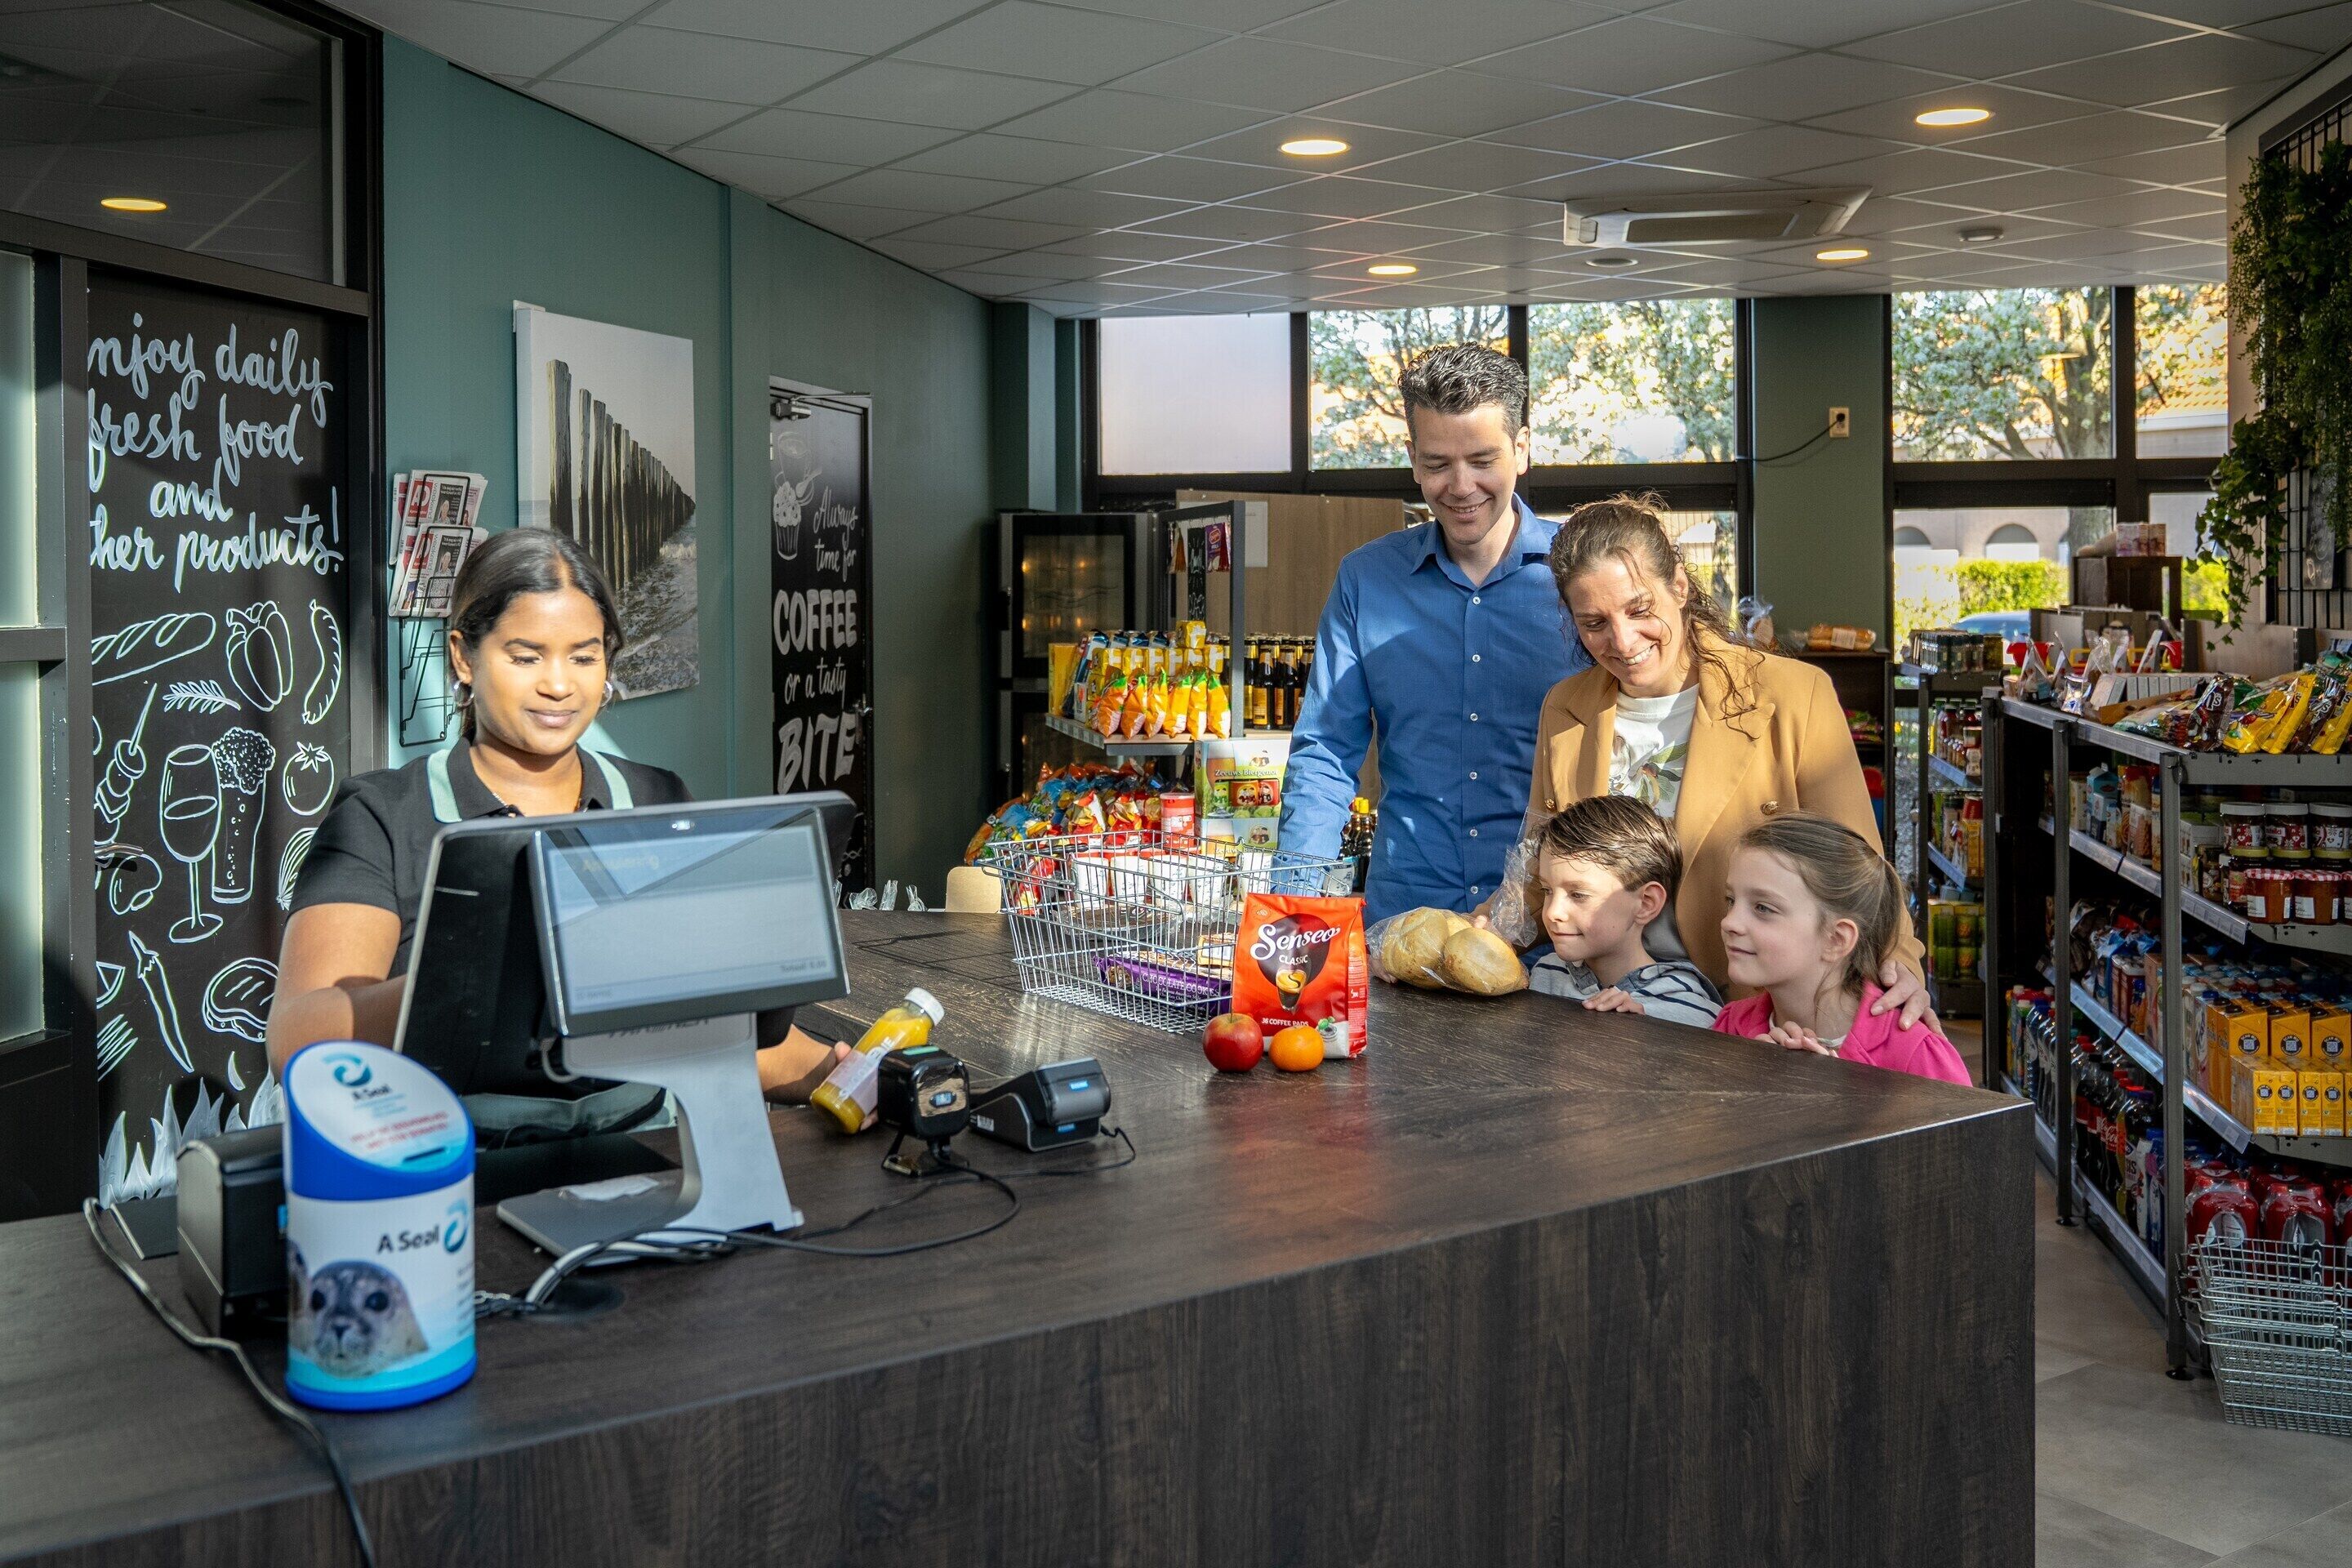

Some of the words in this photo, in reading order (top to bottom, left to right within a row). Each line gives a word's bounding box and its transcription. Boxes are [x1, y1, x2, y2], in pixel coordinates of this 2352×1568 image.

[87, 312, 205, 410] njoy
[216, 323, 333, 428] daily
[88, 388, 201, 492] fresh
[220, 393, 303, 486] food
[150, 457, 233, 521] and
[813, 486, 858, 550] Always
[175, 486, 344, 593] products!
[815, 538, 840, 572] time
[773, 589, 857, 655] COFFEE
[784, 672, 800, 705] or
[805, 679, 814, 700] a
[817, 657, 847, 710] tasty
[777, 711, 857, 795] BITE
[1250, 924, 1341, 960] Senseo
[1279, 954, 1308, 965] CLASSIC
[1269, 1018, 1291, 1027] COFFEE
[377, 1232, 394, 1255] A
[398, 1223, 440, 1252] Seal
